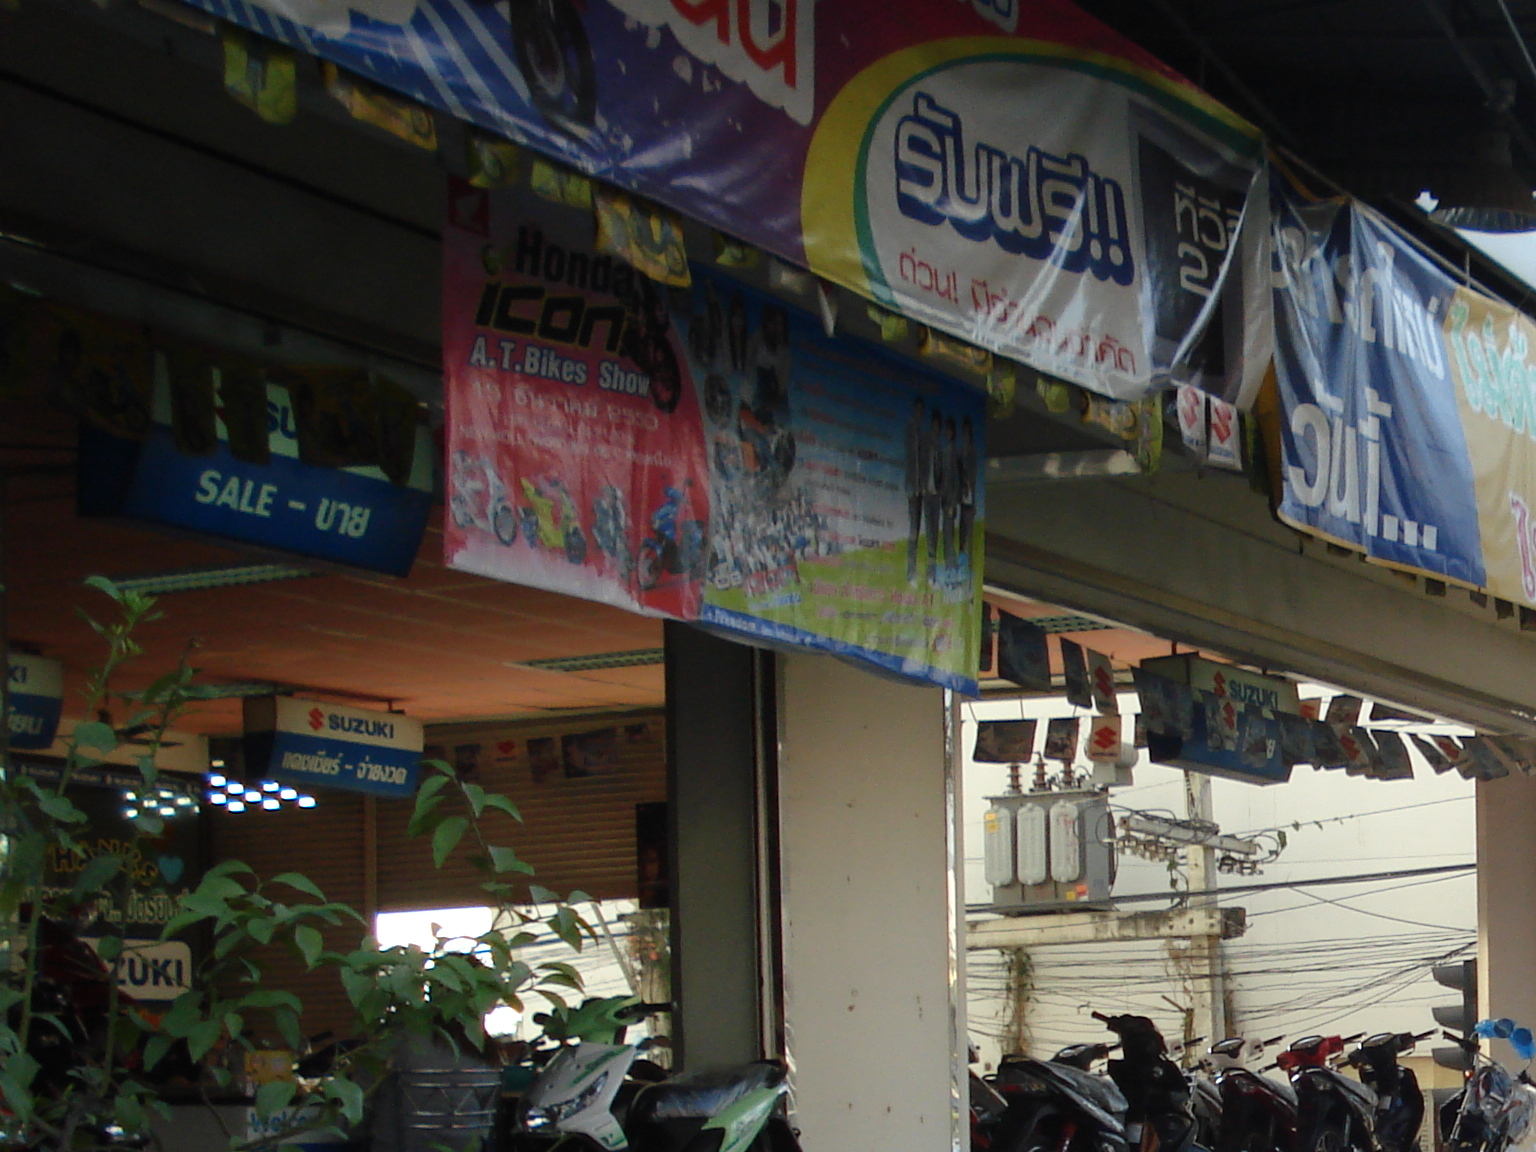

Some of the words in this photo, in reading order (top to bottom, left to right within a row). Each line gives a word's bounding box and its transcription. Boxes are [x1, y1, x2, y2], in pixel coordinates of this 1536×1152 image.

[894, 92, 1135, 285] รับฟรี!!
[514, 225, 636, 302] Honda
[898, 246, 959, 305] ด่วน!
[598, 360, 651, 399] Show
[194, 469, 279, 519] SALE
[314, 496, 374, 540] ขาย
[1229, 678, 1279, 709] SUZUKI
[328, 713, 395, 739] SUZUKI
